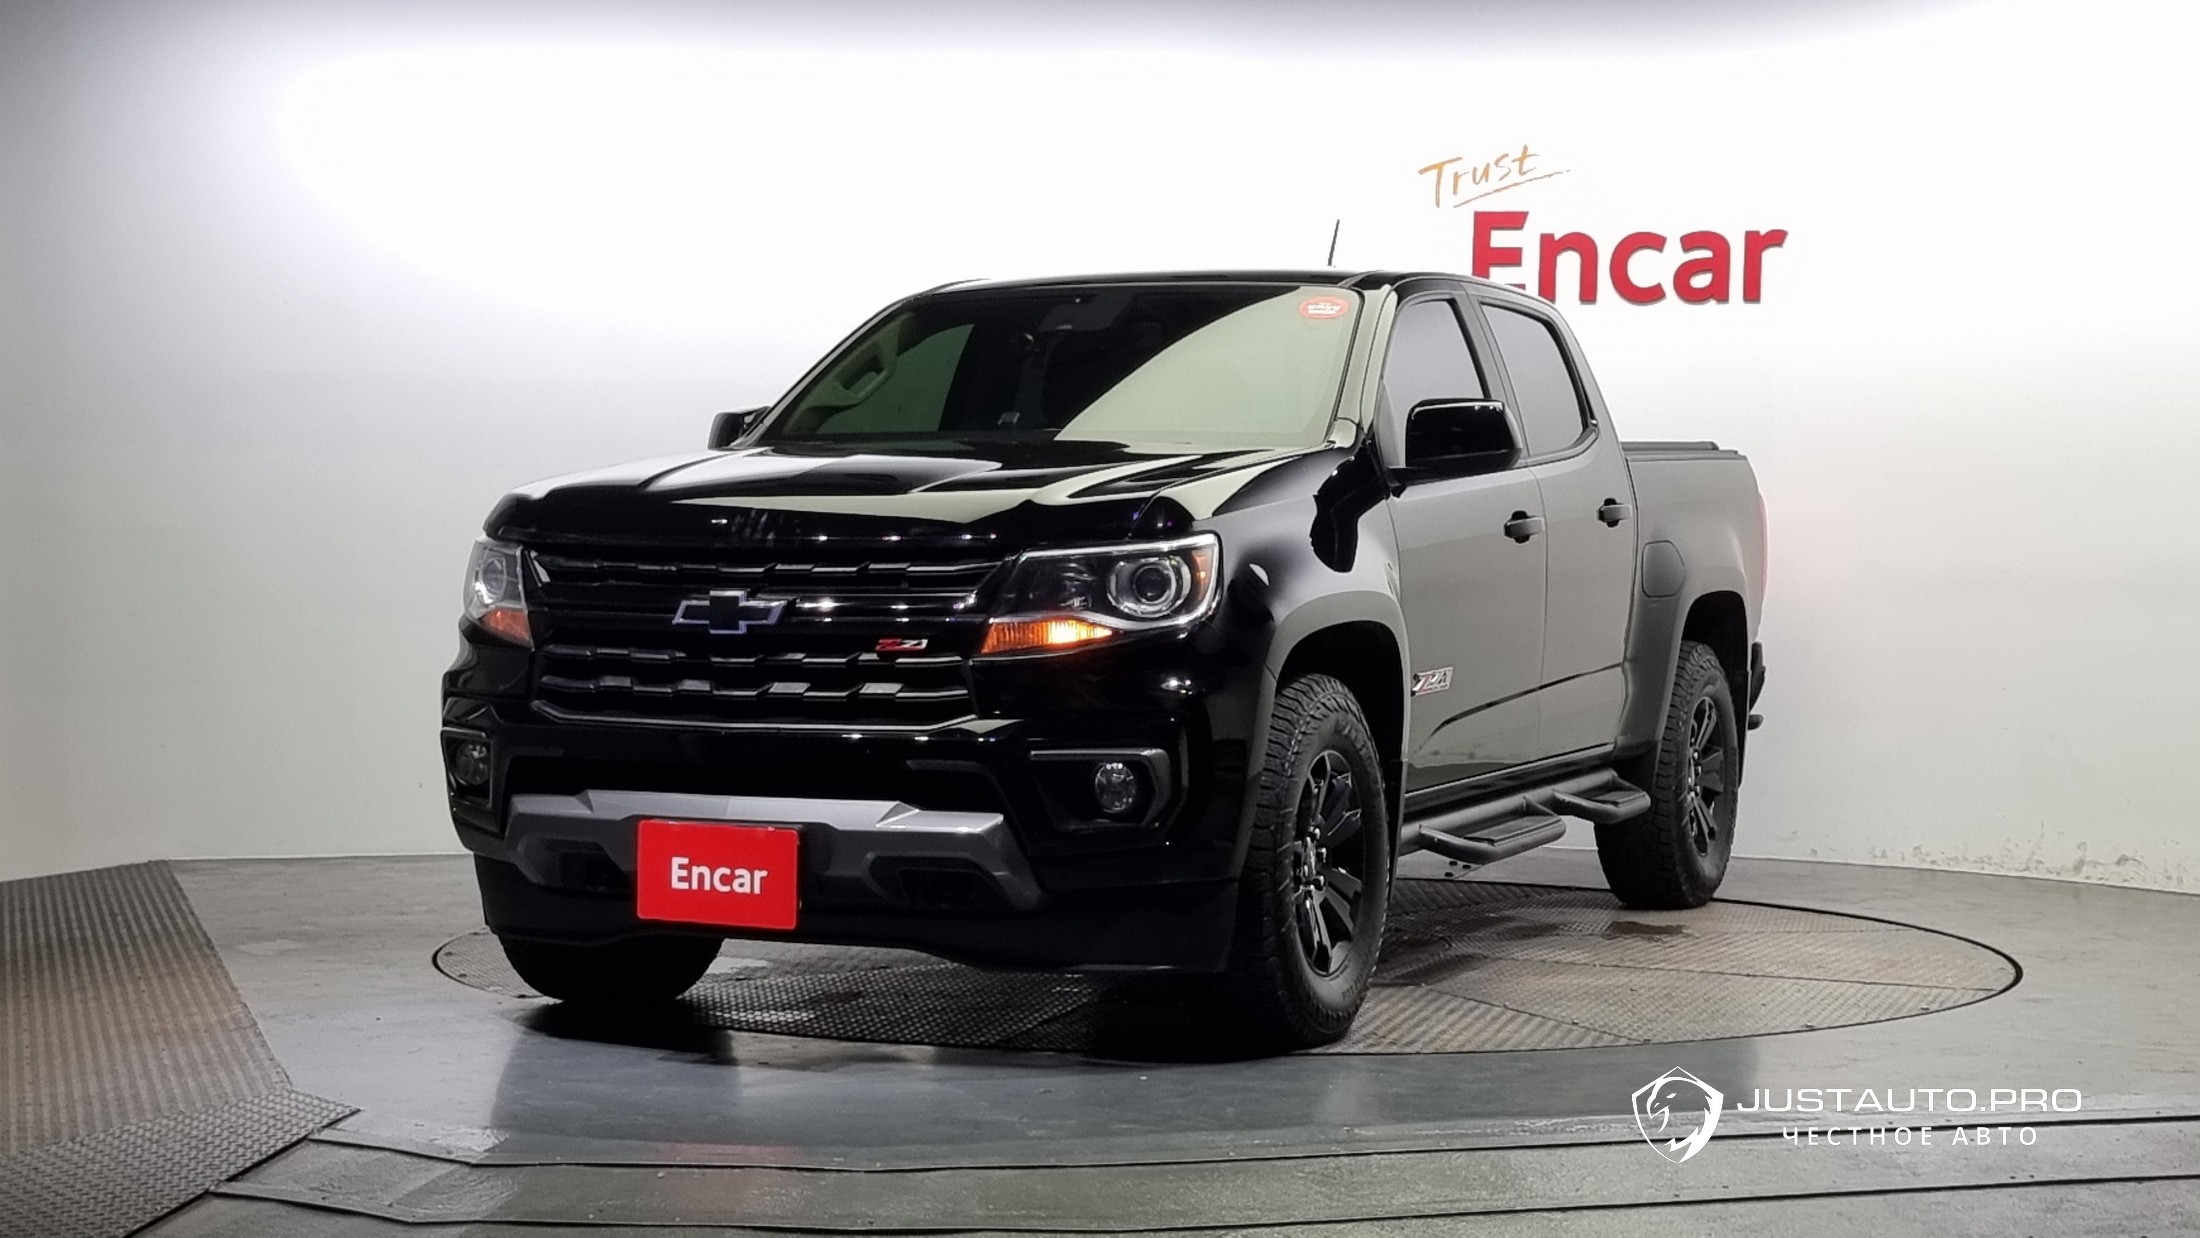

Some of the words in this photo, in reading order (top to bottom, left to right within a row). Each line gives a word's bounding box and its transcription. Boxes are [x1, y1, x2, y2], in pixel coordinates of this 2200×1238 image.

[1417, 143, 1540, 208] Trust
[1471, 210, 1789, 305] Encar
[671, 856, 769, 895] Encar
